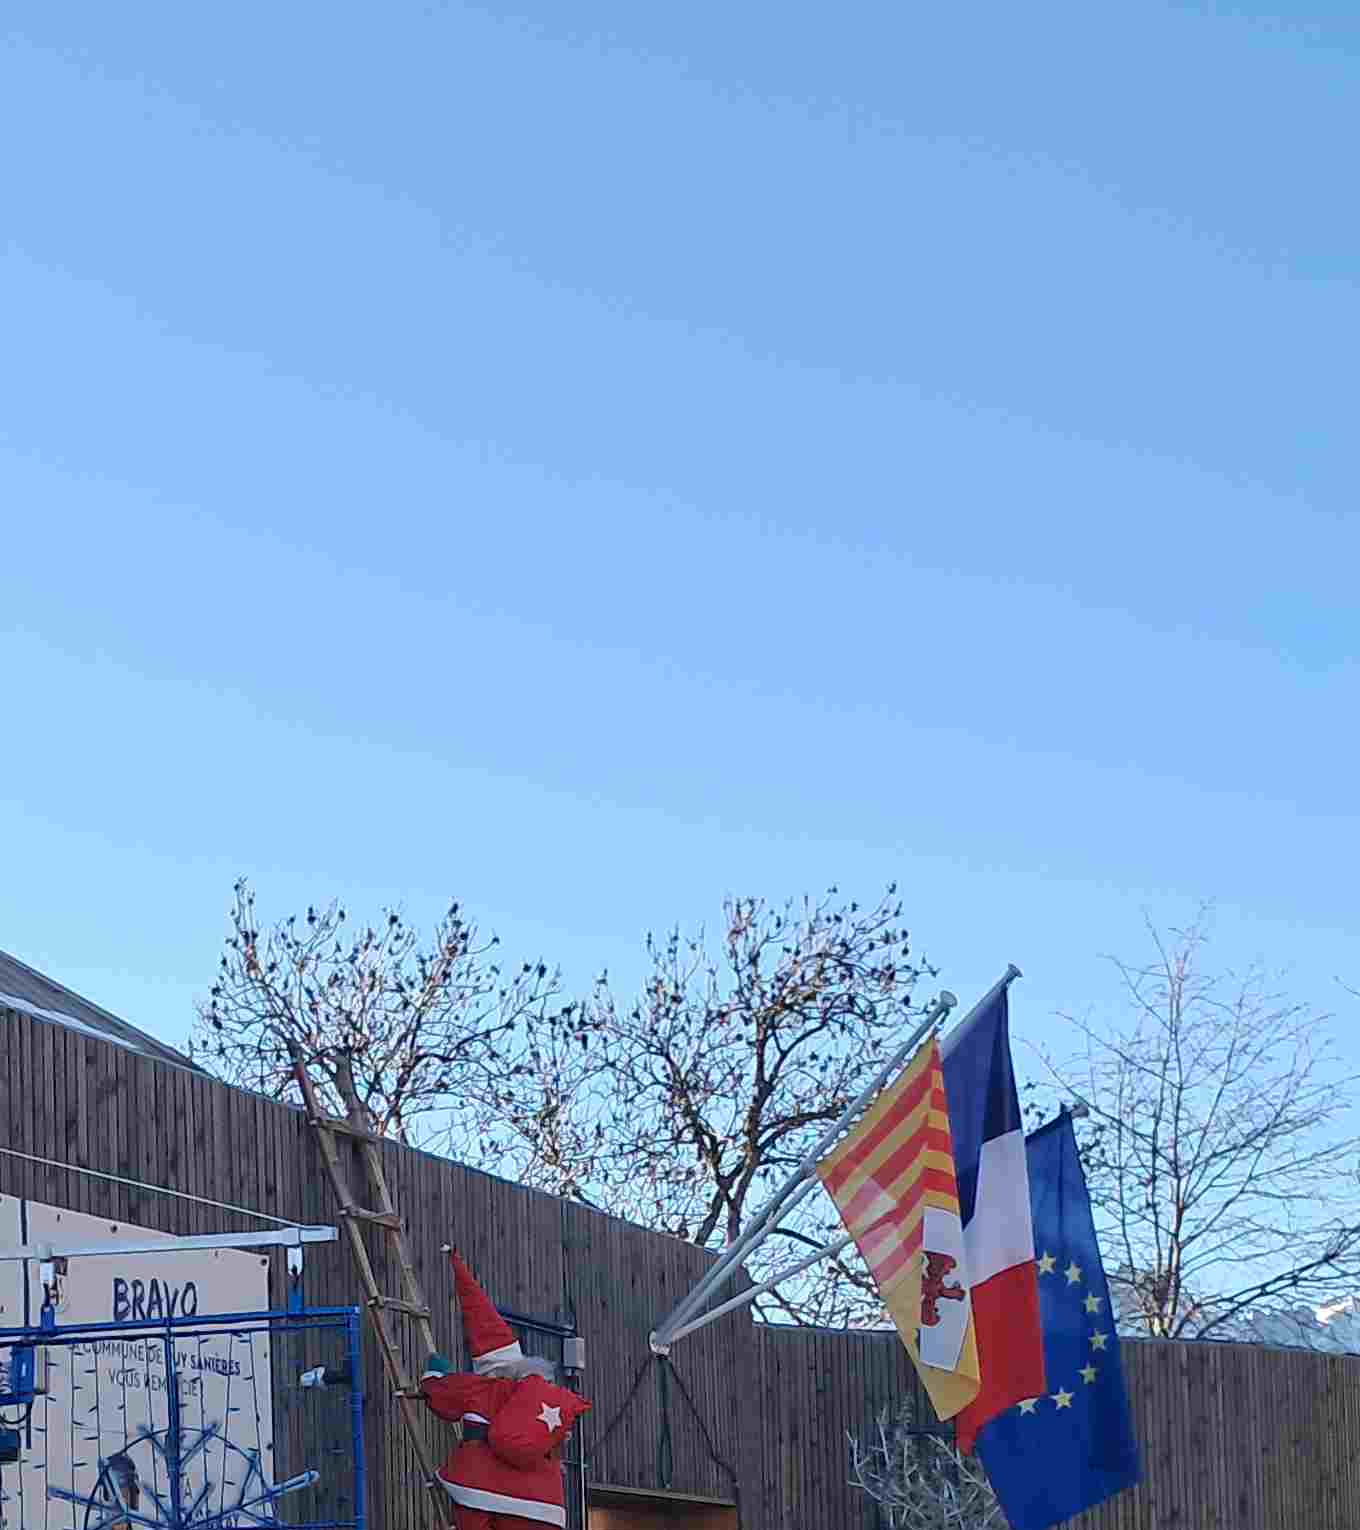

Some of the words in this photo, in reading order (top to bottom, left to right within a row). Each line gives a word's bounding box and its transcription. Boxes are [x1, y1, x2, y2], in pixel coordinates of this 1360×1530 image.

[112, 1277, 197, 1321] BRAVO
[108, 1368, 140, 1388] VOUS
[143, 1374, 198, 1397] REMCIE
